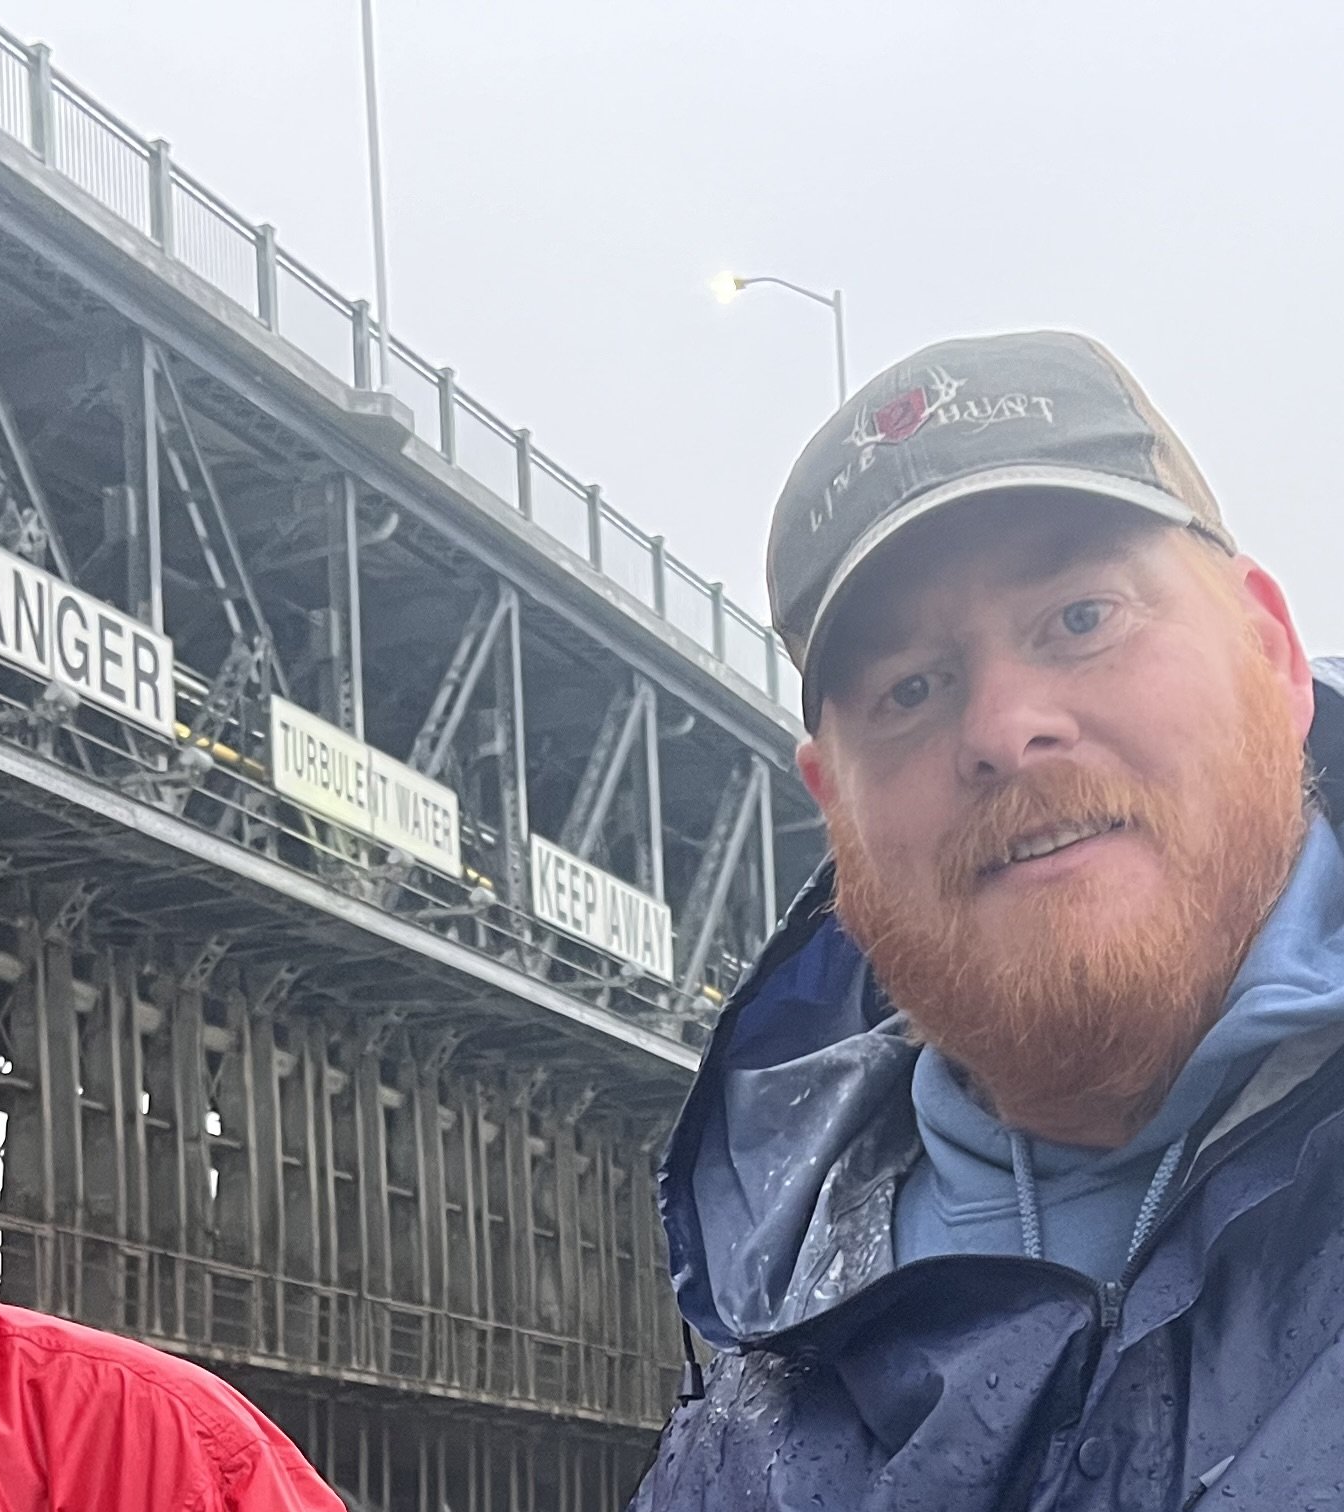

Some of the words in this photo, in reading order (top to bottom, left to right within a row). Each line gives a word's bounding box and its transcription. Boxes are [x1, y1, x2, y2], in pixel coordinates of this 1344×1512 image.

[279, 719, 388, 823] TURBULENT
[394, 780, 454, 857] WATER
[537, 845, 597, 936] KEEP
[607, 883, 667, 973] AWAY
